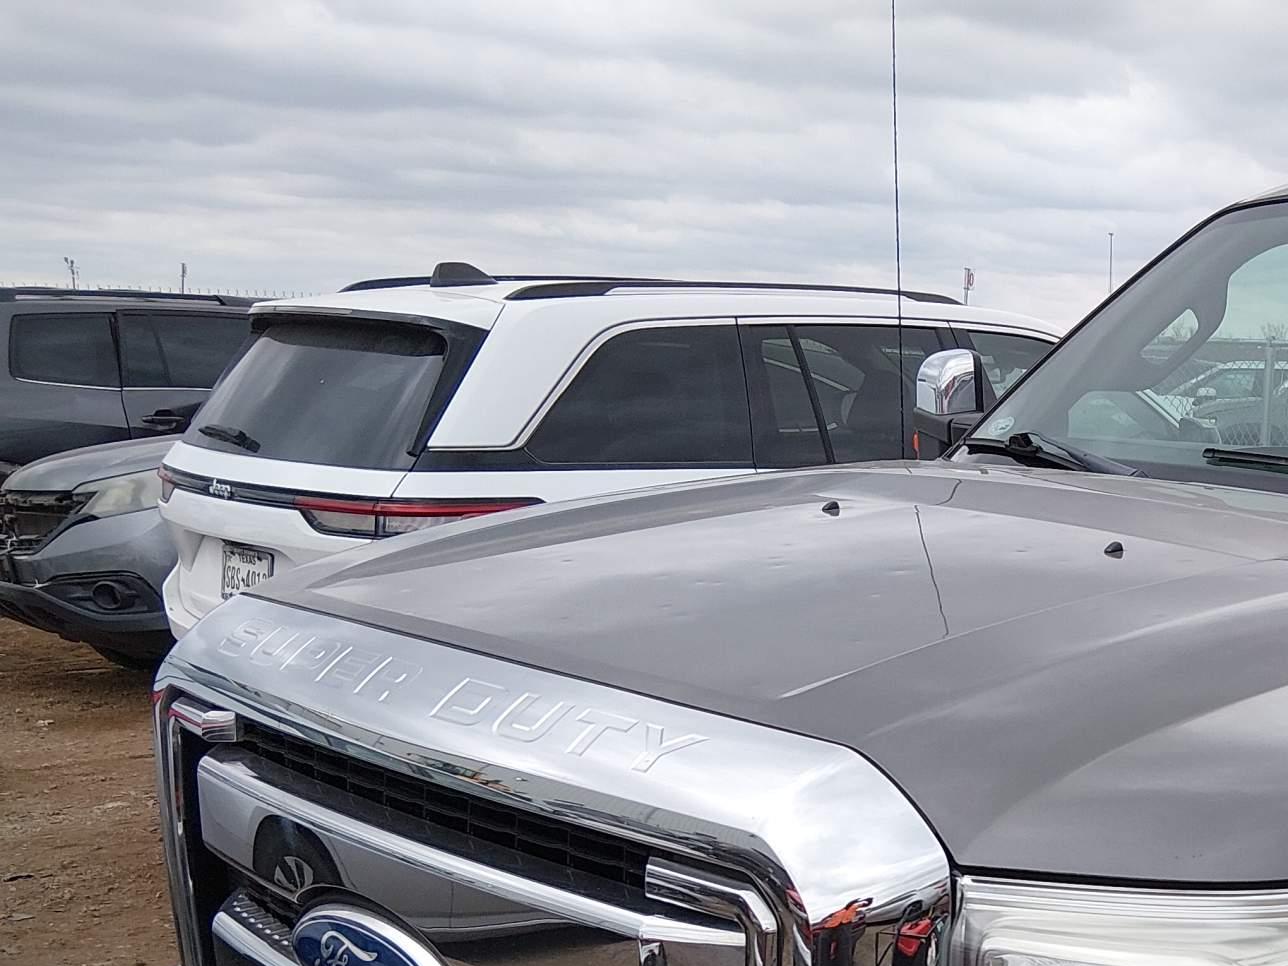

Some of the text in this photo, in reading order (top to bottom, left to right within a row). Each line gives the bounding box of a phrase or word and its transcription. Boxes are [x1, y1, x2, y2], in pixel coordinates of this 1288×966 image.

[209, 478, 231, 500] Jeep
[215, 617, 712, 774] SUPER DUTY
